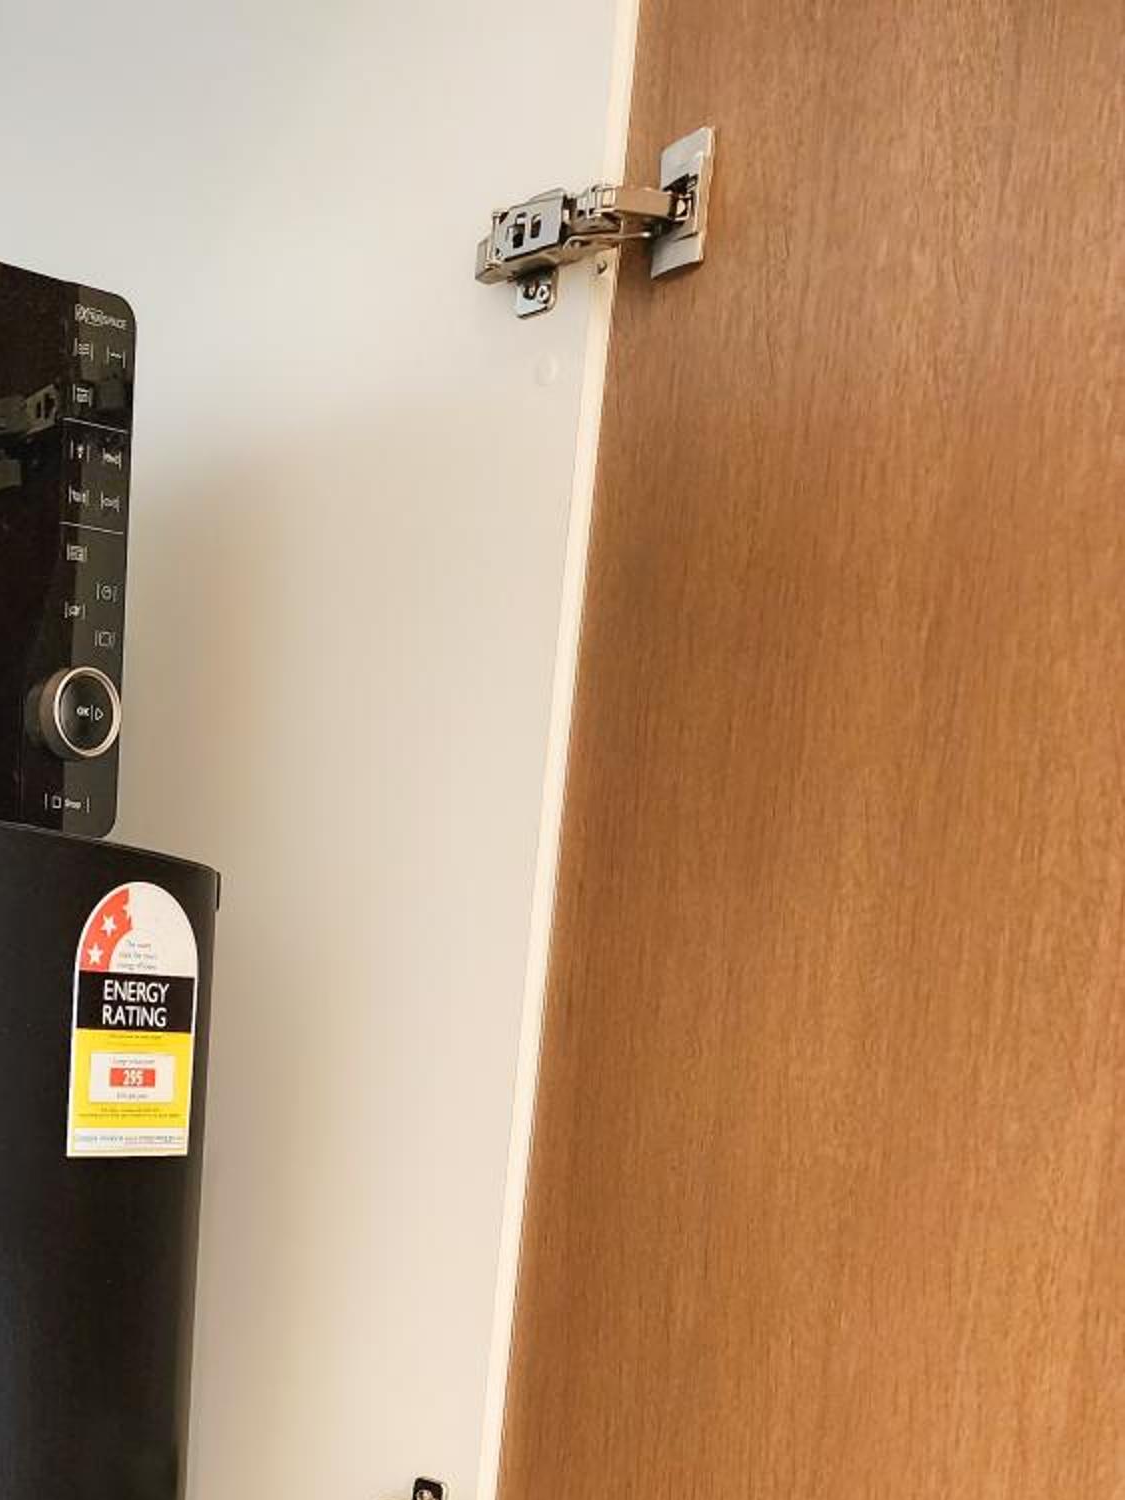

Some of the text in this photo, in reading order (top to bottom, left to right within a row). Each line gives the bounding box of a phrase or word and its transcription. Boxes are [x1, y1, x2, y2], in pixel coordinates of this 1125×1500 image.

[76, 706, 90, 717] OK
[103, 979, 170, 1003] ENERGY
[101, 1005, 167, 1028] RATING
